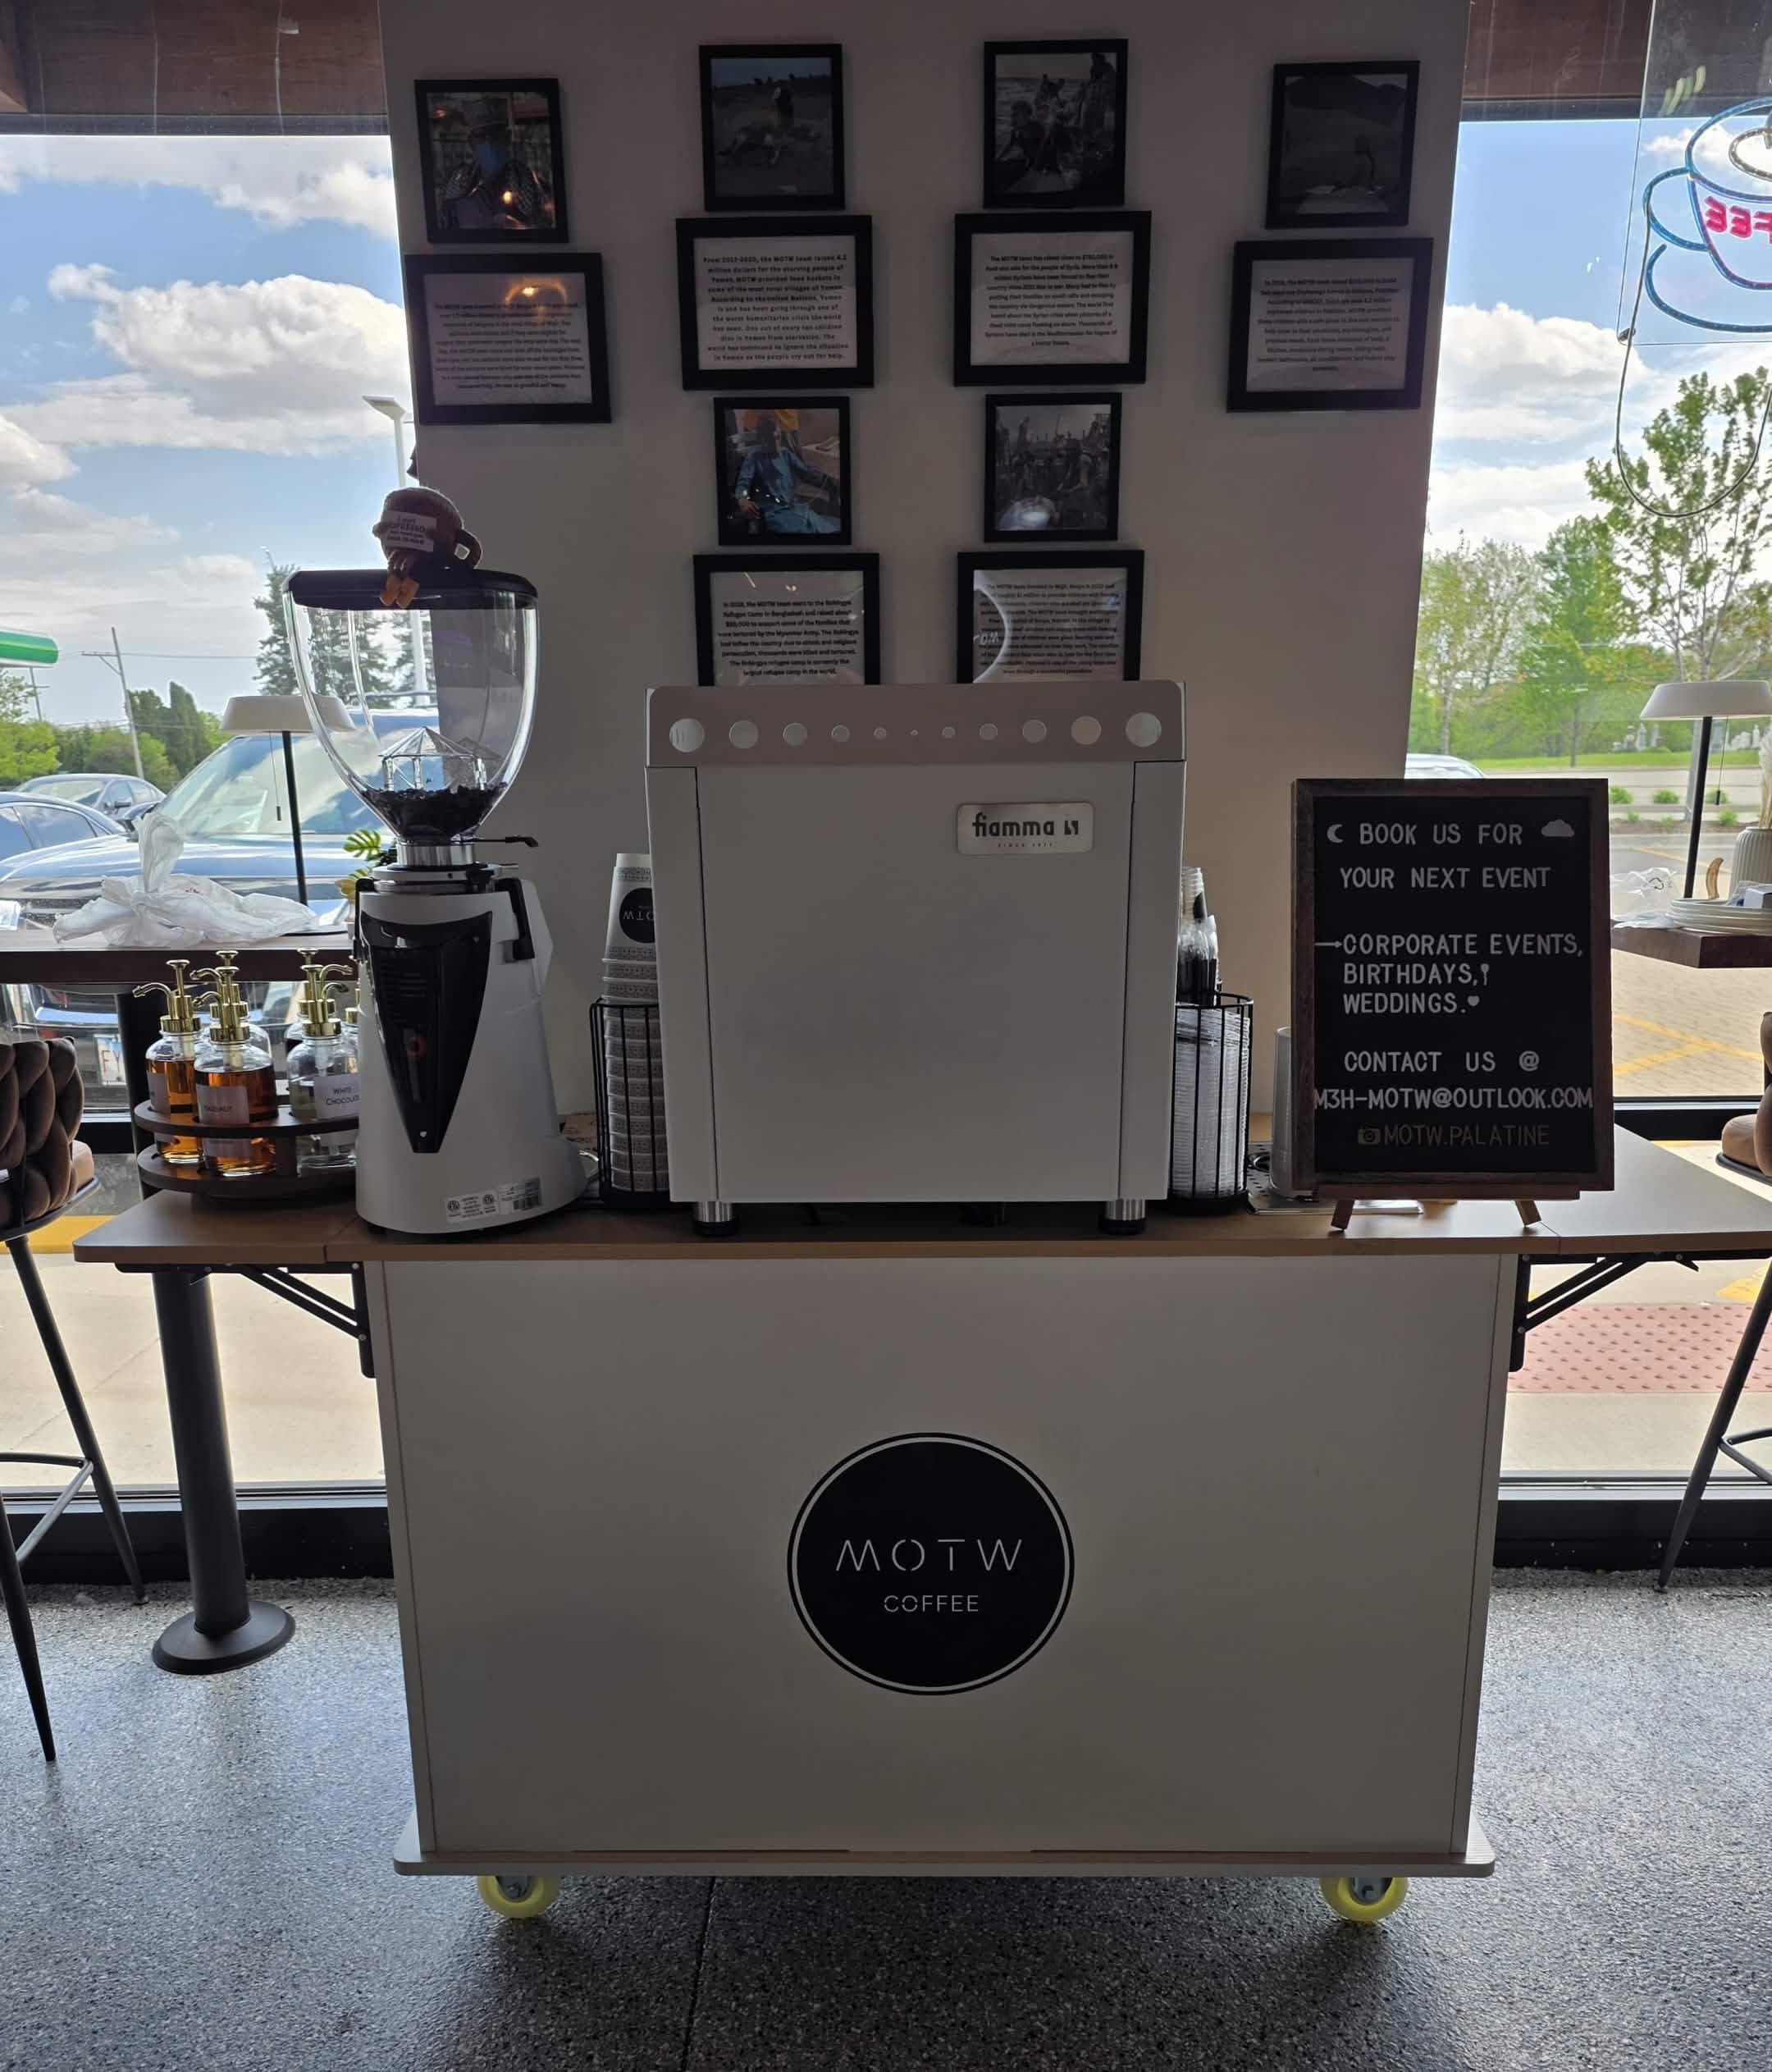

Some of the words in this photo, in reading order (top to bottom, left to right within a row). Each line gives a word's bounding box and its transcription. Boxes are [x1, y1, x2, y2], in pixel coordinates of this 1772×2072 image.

[972, 812, 1055, 838] fiamma
[1359, 823, 1417, 845] BOOK
[1432, 823, 1462, 844] US
[1477, 823, 1523, 845] FOR
[1340, 867, 1395, 890] YOUR
[1410, 867, 1471, 889] NEXT
[1482, 867, 1551, 888] EVENT
[1342, 933, 1477, 956] CORPORATE
[1489, 933, 1583, 957] EVENTS,
[1343, 963, 1479, 986] BIRTHDAYS,
[1342, 992, 1467, 1014] WEDDINGS.
[1344, 1050, 1442, 1072] CONTACT
[1465, 1050, 1496, 1072] US
[1519, 1050, 1540, 1072] @
[1313, 1087, 1593, 1109] M3H-MOTW@OUTLOOK.COM
[1384, 1124, 1550, 1146] MOTW.PALATINE
[835, 1538, 1023, 1571] MOTW
[883, 1594, 980, 1613] COFFEE
